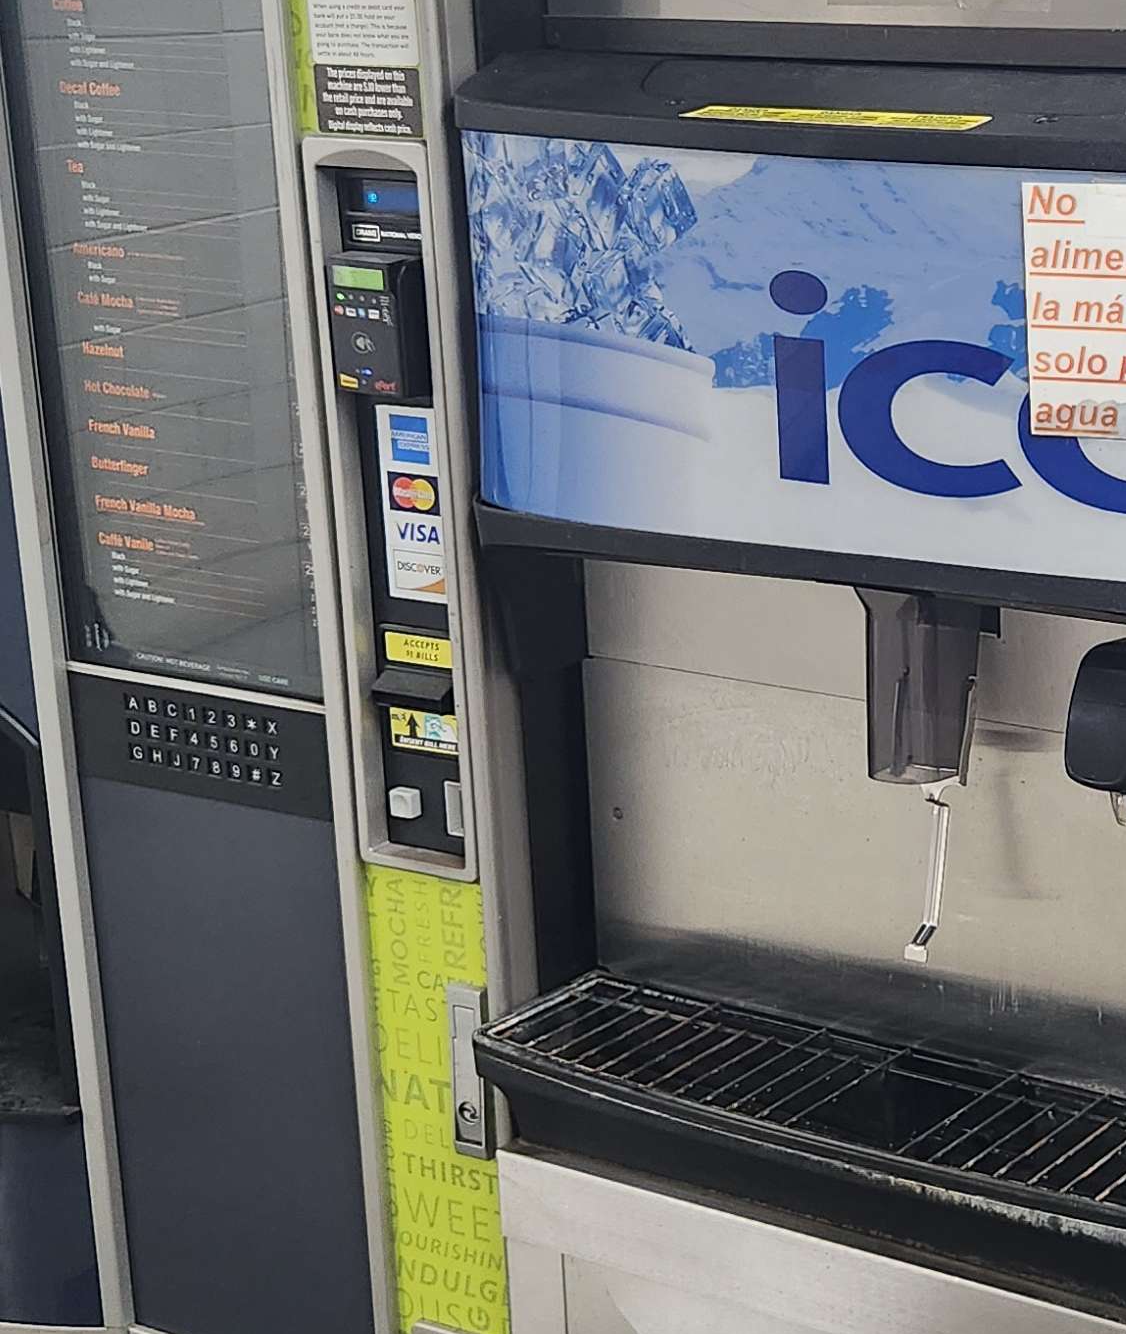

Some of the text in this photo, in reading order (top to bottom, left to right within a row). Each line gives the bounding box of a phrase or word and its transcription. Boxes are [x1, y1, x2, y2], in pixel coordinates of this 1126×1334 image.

[89, 82, 121, 97] Coffee
[66, 159, 84, 174] Tea
[1028, 185, 1078, 216] No
[72, 242, 125, 259] Americano
[100, 293, 134, 309] Mocha
[1031, 291, 1061, 322] la
[82, 341, 124, 359] Hazelnut
[1033, 345, 1108, 375] solo
[84, 379, 101, 393] Hot
[102, 381, 151, 400] Chocolate
[1035, 401, 1119, 431] agua
[88, 418, 156, 440] French Vanilla
[91, 455, 149, 477] Butterfinger
[95, 494, 196, 521] French Vanilla Mocha
[396, 522, 441, 545] VISA
[397, 560, 442, 576] DISCOVER
[403, 638, 440, 651] ACCEPTS
[416, 650, 439, 662] BILLS
[128, 697, 278, 735] A B C 1 2 3 X
[130, 721, 279, 760] D E F 4 5 6 0 Y
[132, 745, 281, 786] G H J 7 8 9 # Z
[386, 878, 410, 986] MOCHA
[415, 879, 432, 964] FRESH
[417, 969, 452, 992] CA
[386, 987, 448, 1023] TAS
[402, 1151, 499, 1195] THIRST
[403, 1186, 501, 1244] WEE
